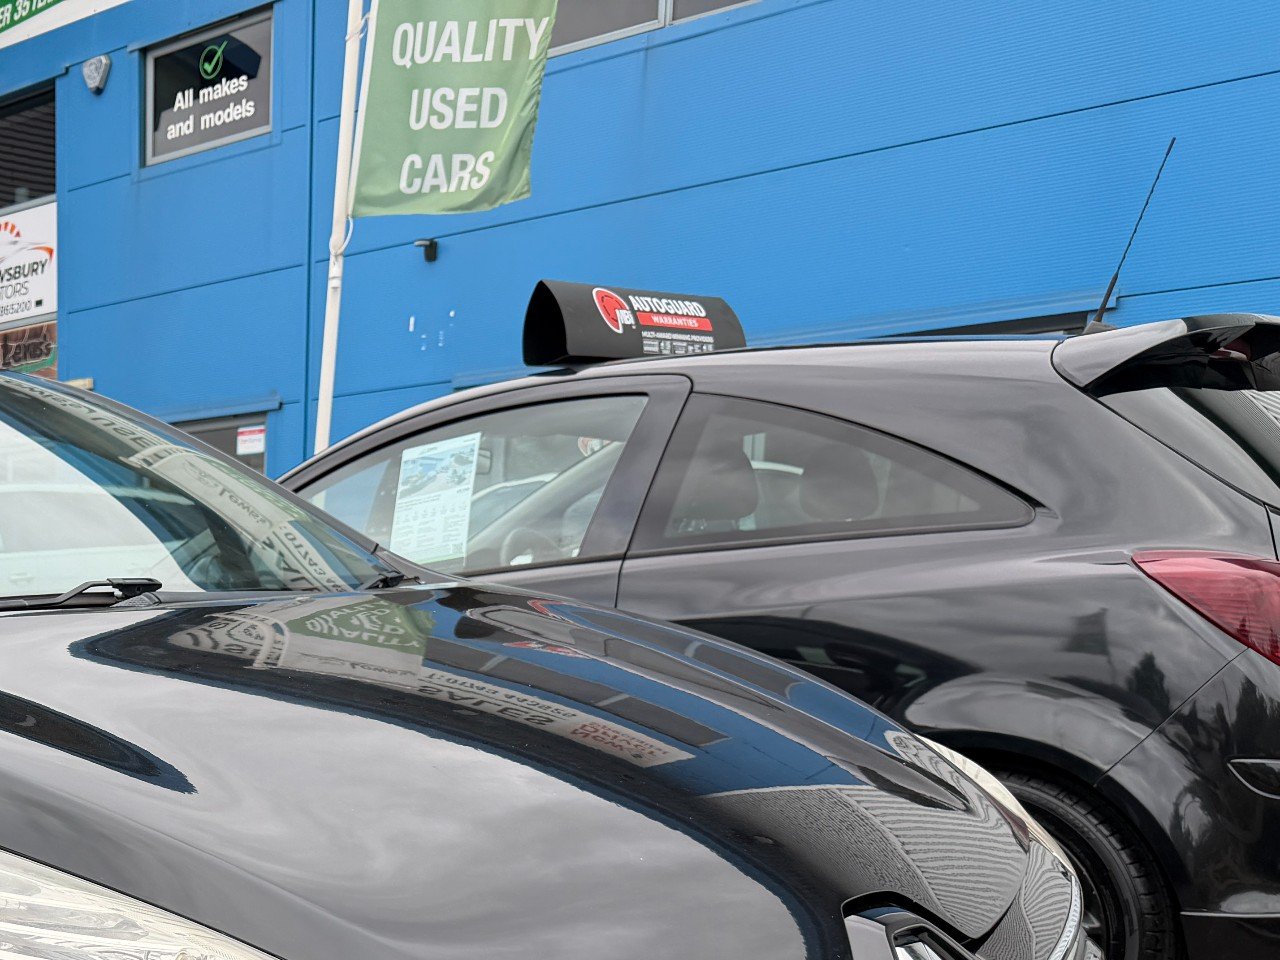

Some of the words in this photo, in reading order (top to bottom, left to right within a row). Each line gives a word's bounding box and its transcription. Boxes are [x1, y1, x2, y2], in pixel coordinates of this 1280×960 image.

[392, 16, 550, 68] QUALITY
[173, 88, 194, 112] All
[199, 75, 249, 104] makes
[409, 87, 508, 130] USED
[167, 114, 195, 140] and
[200, 97, 256, 130] models
[399, 151, 495, 194] CARS
[628, 295, 707, 317] AUTOGUARD
[651, 314, 699, 328] WARRANTIES
